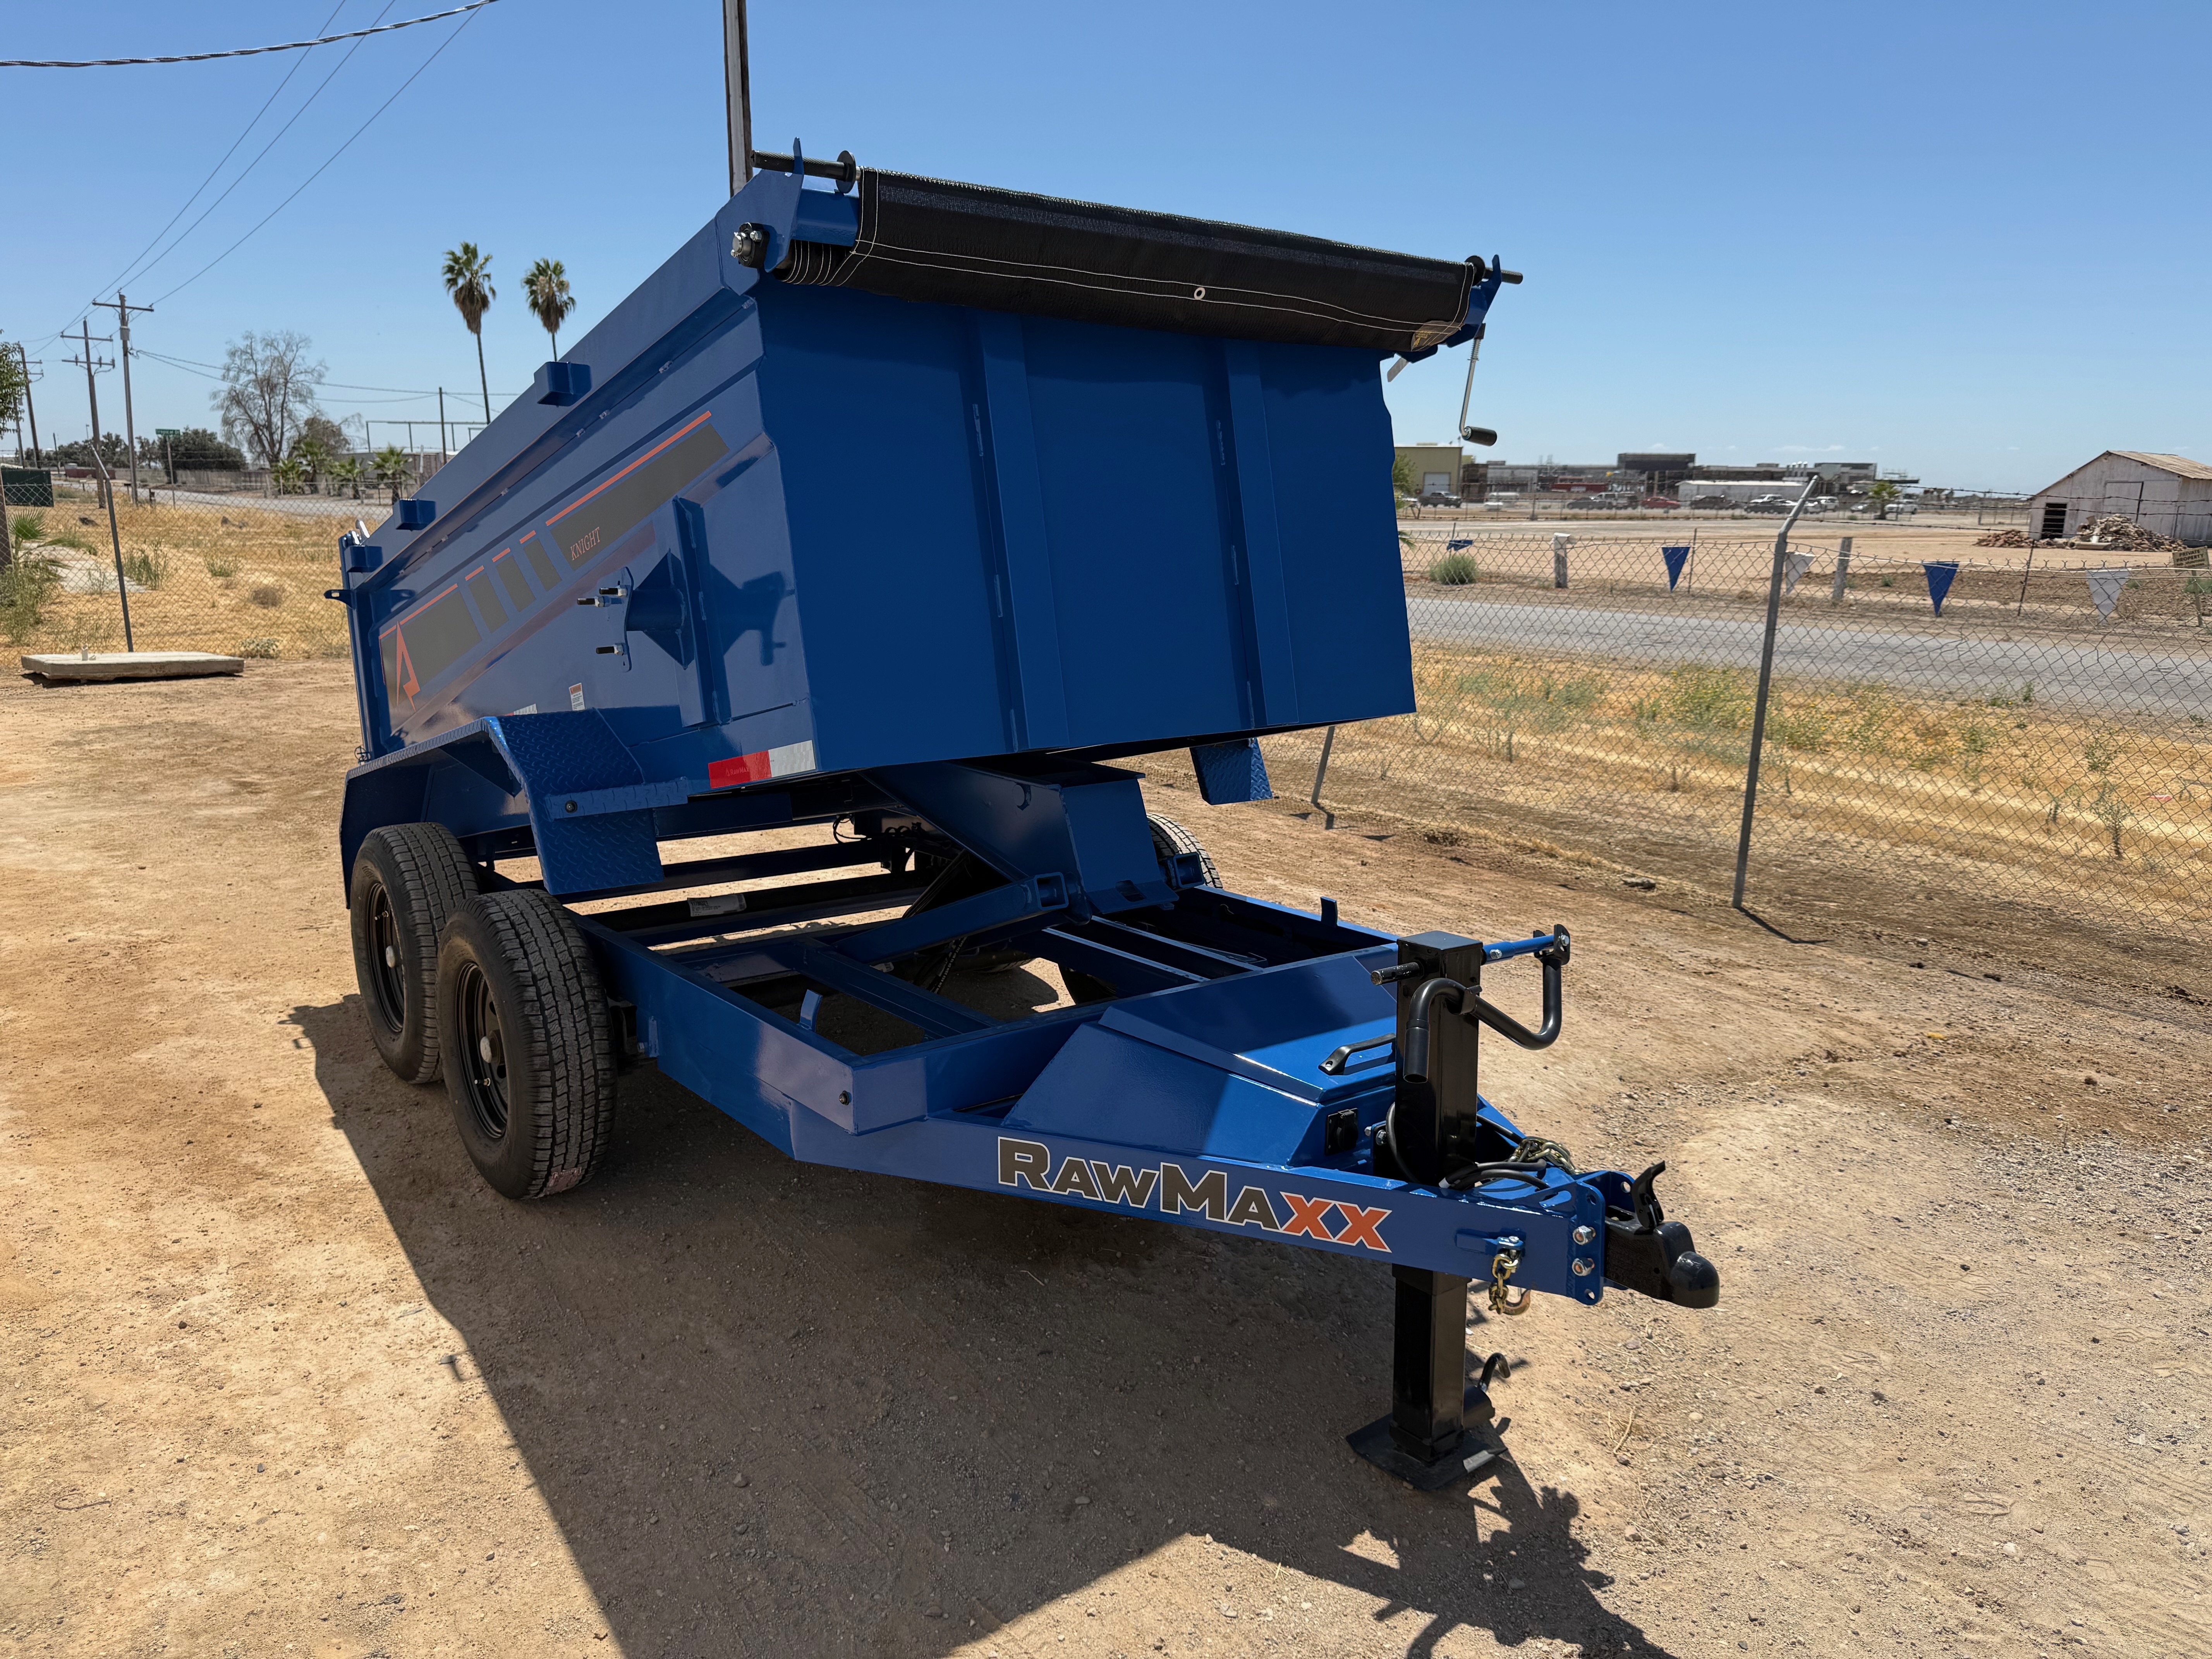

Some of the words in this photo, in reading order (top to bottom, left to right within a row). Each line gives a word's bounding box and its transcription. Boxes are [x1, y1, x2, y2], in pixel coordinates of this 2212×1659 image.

[570, 527, 600, 560] KNIGHT
[2176, 554, 2203, 562] PROPERTY
[998, 1136, 1393, 1253] RAWMAXX
